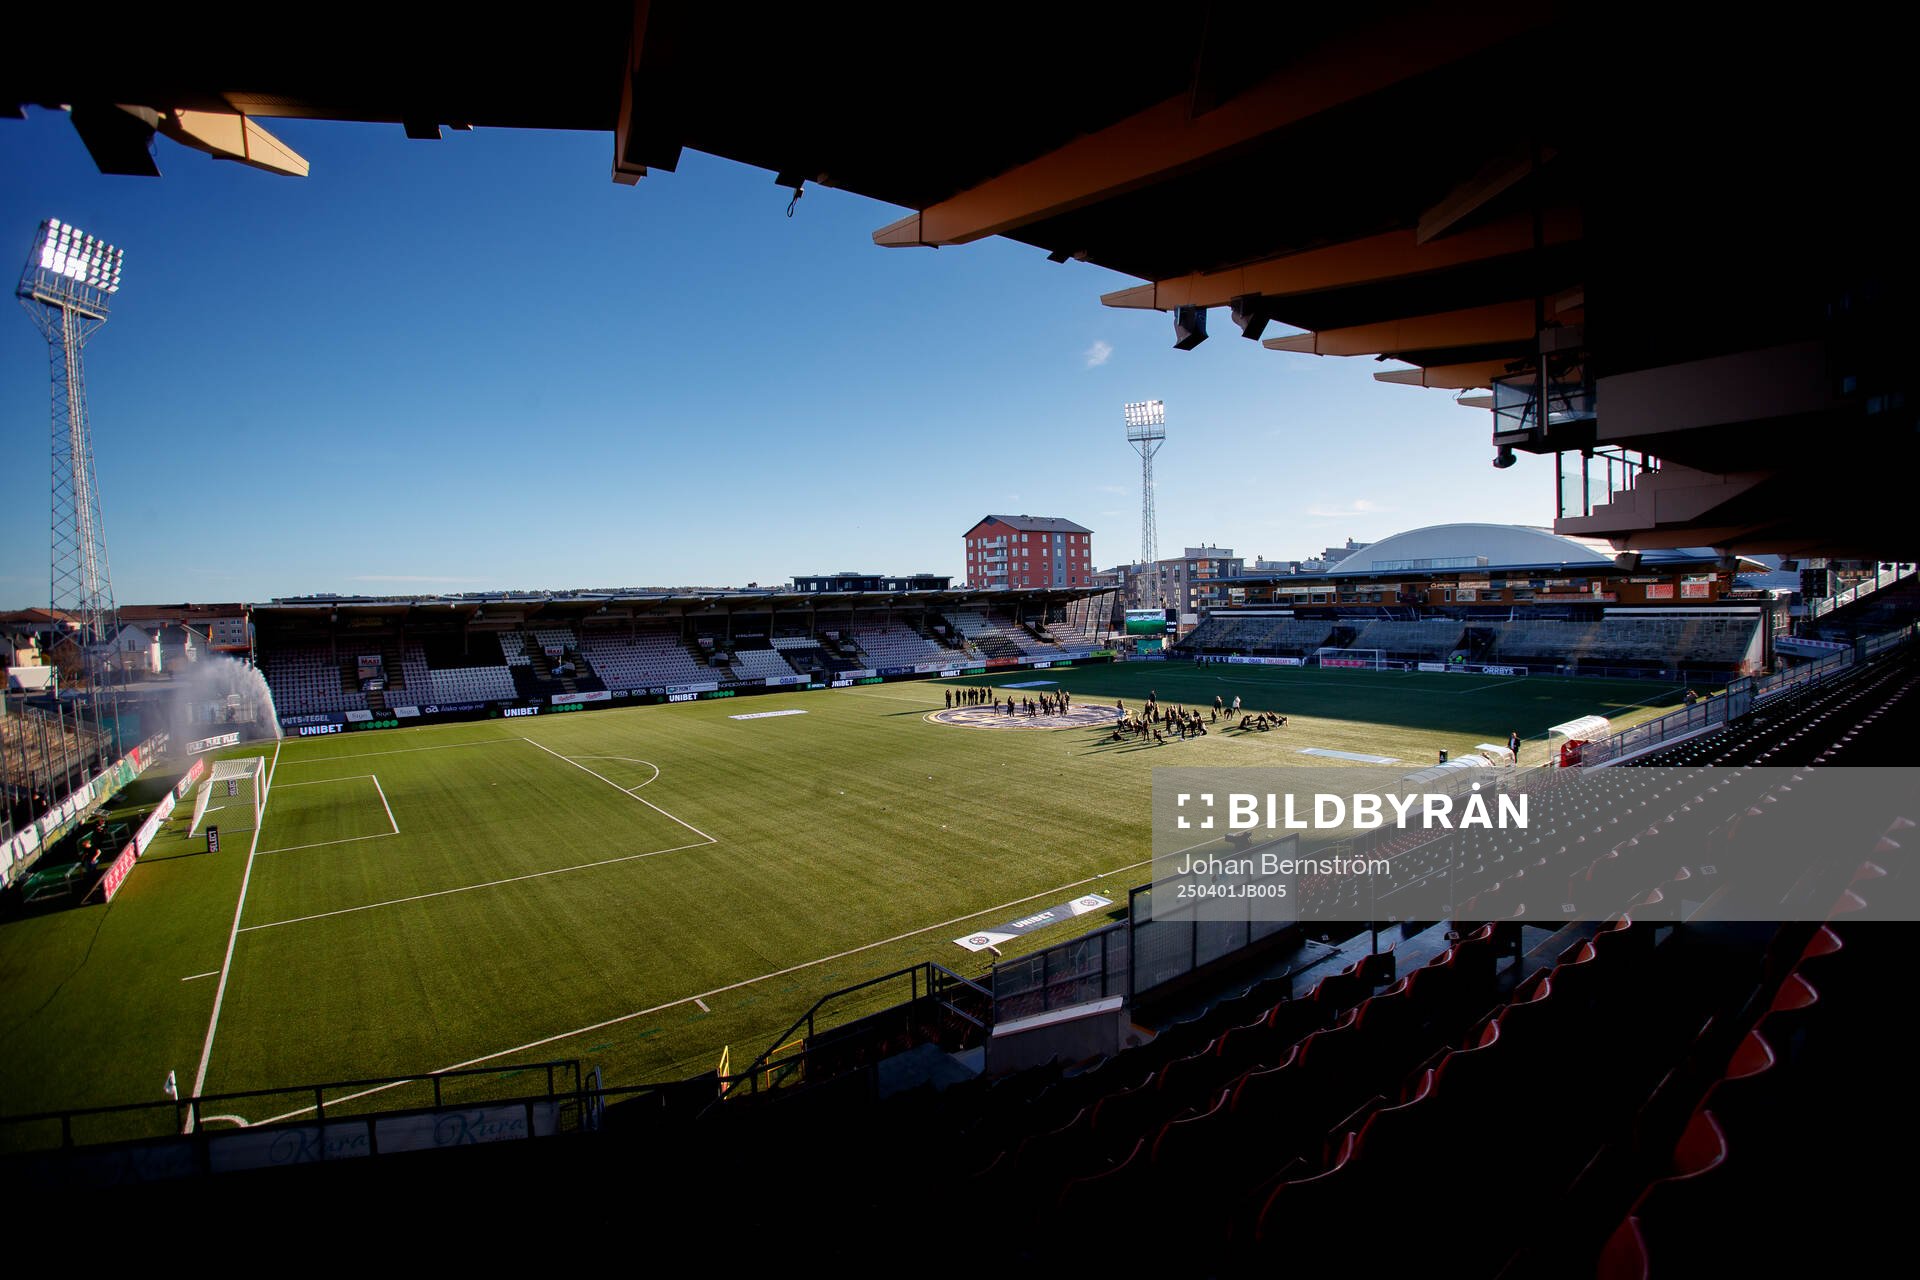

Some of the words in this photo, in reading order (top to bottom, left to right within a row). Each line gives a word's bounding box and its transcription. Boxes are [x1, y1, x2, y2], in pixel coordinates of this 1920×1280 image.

[669, 693, 698, 702] UNIBET
[504, 707, 539, 717] UNIBET
[300, 724, 343, 736] UNIBET
[208, 831, 218, 853] SELECT
[1012, 911, 1054, 928] UNIBET
[433, 1111, 524, 1147] Kura
